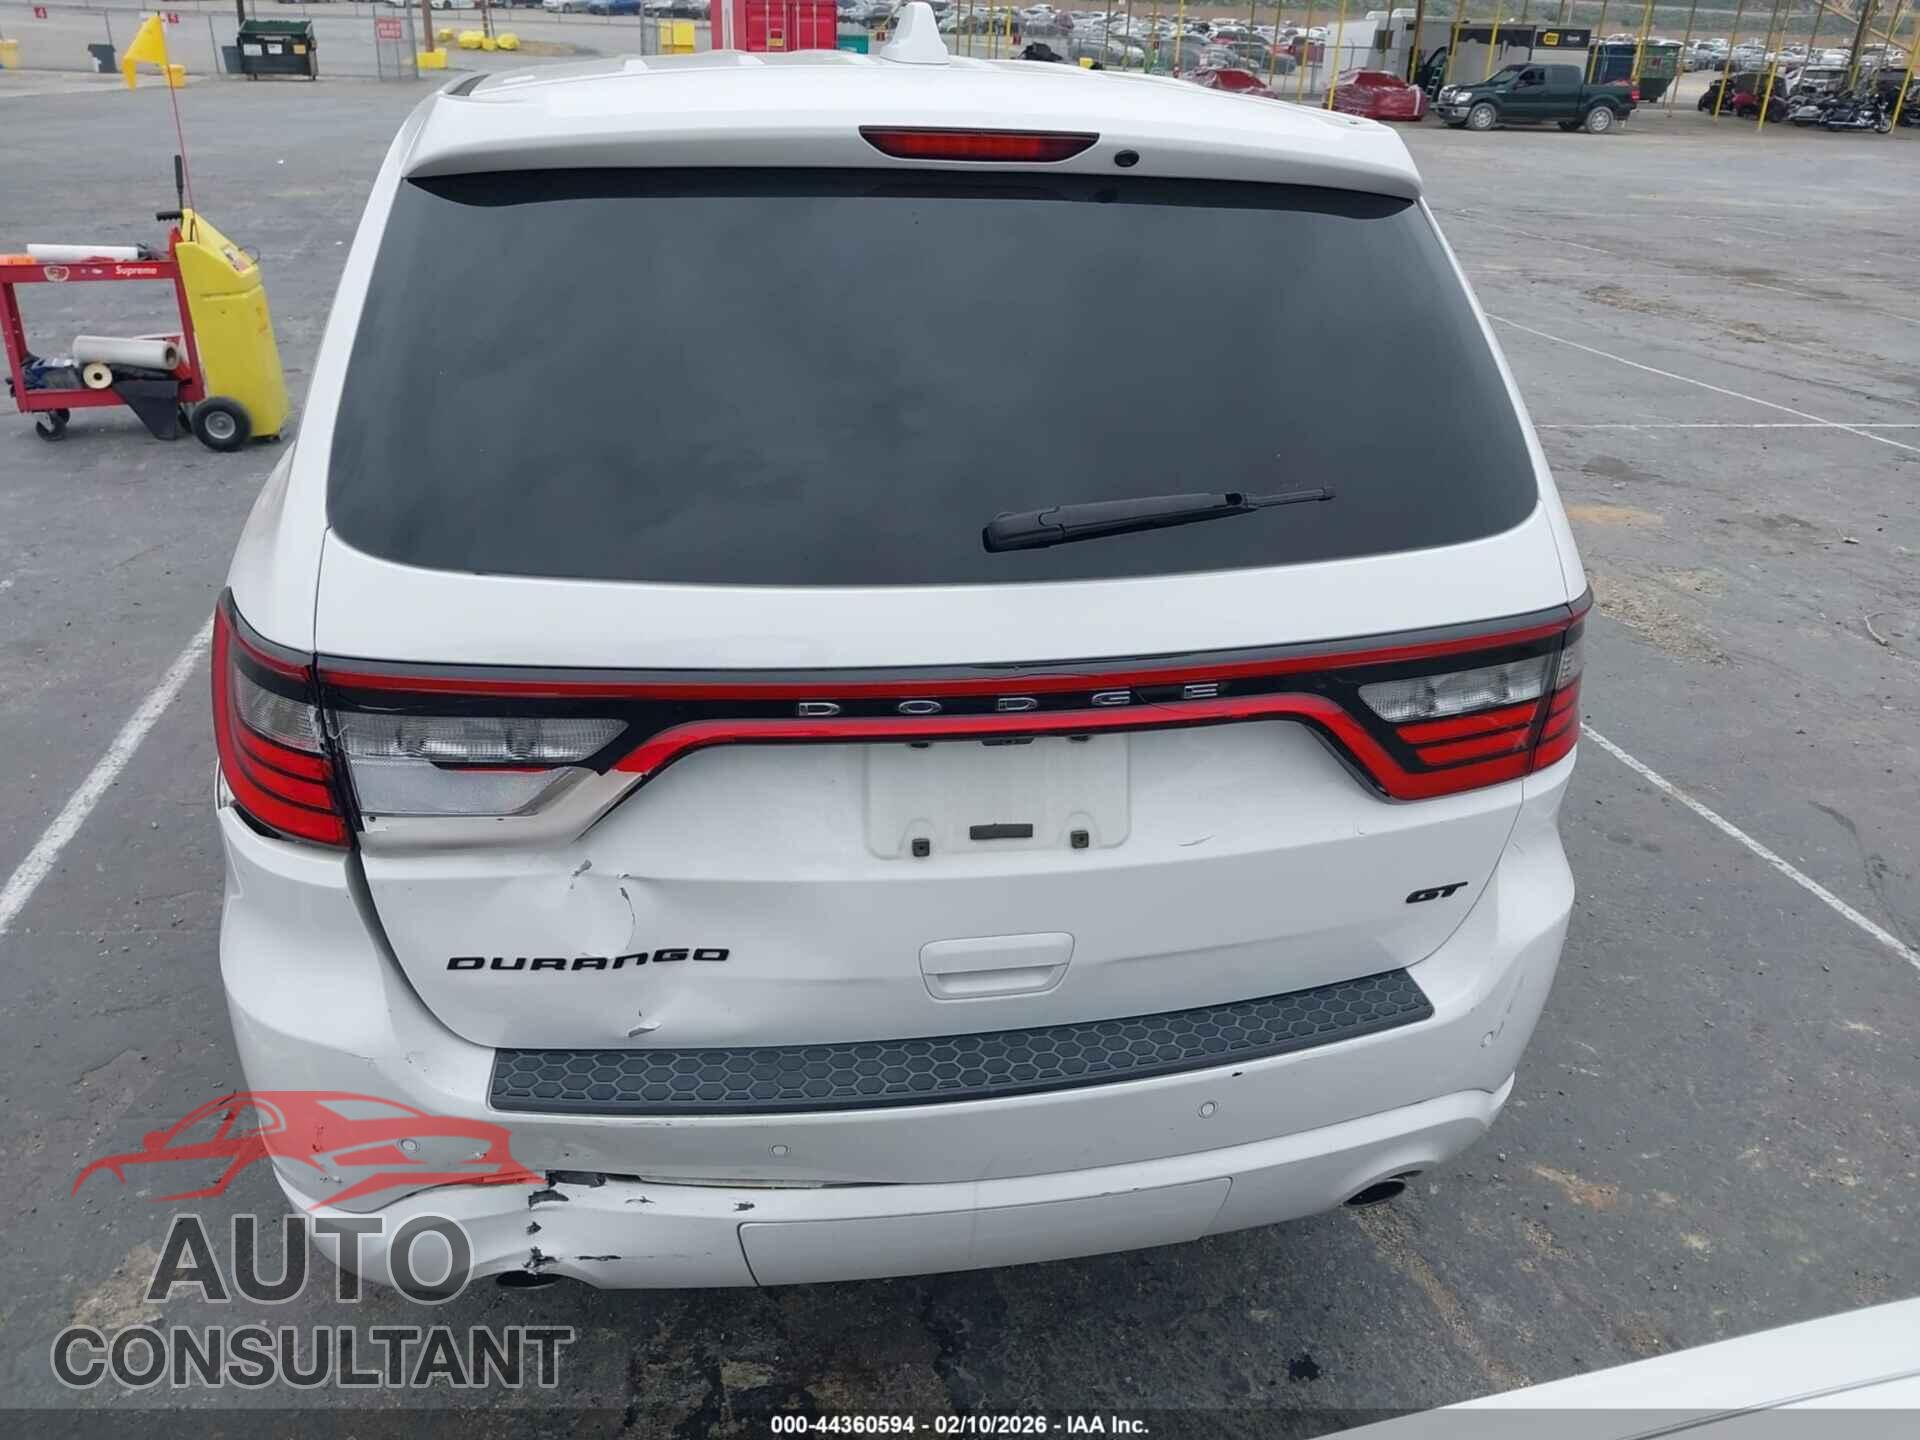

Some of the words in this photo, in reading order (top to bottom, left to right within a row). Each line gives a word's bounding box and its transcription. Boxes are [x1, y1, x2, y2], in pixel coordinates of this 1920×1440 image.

[115, 264, 158, 277] Supreme
[799, 683, 1219, 716] DODGE
[1405, 881, 1468, 904] GT
